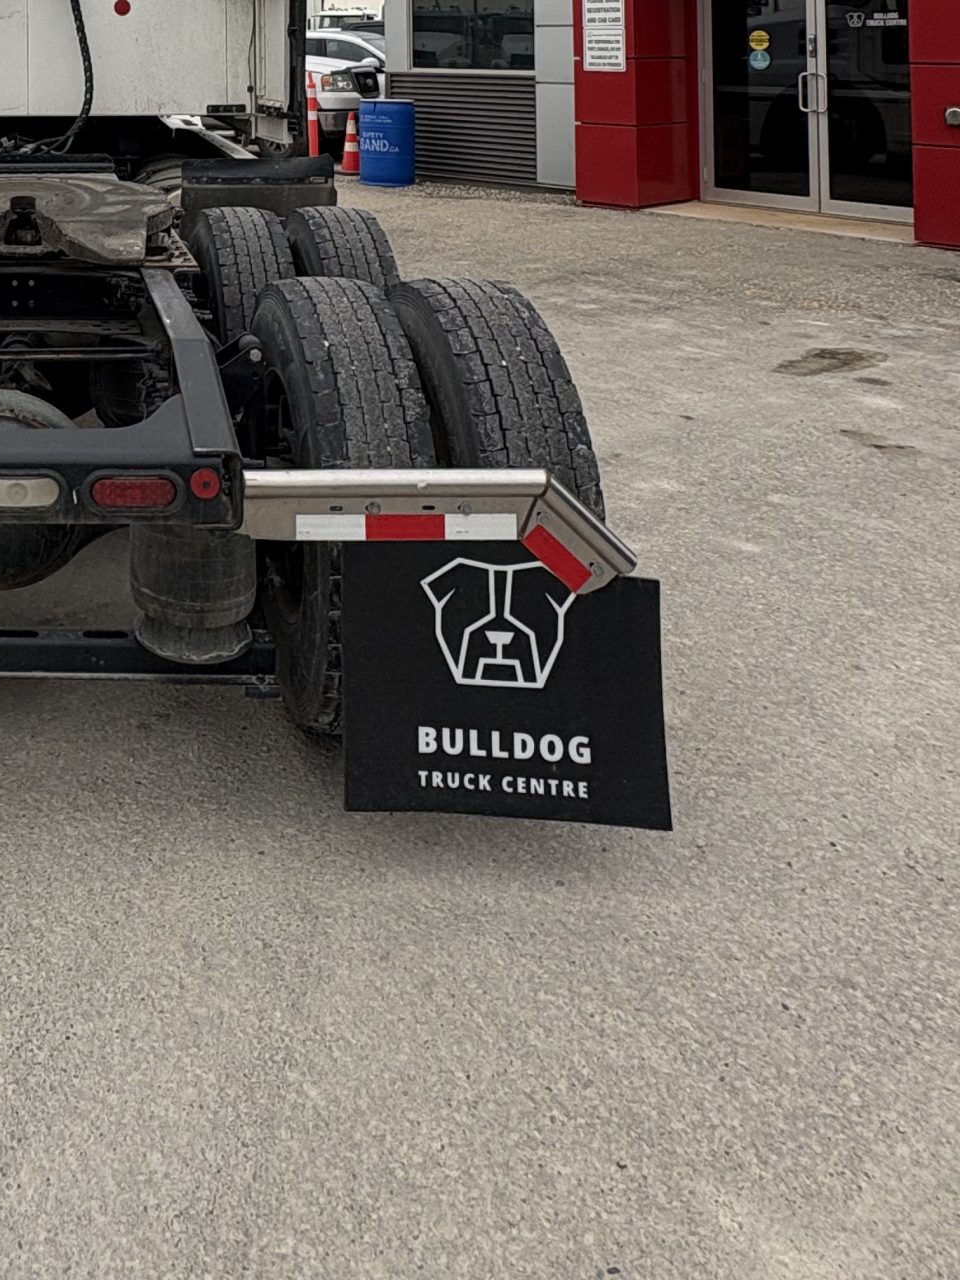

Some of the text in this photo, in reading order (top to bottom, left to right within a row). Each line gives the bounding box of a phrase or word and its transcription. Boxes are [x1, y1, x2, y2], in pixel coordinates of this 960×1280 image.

[417, 725, 592, 765] BULLDOG
[417, 770, 589, 799] TRUCK CENTRE
